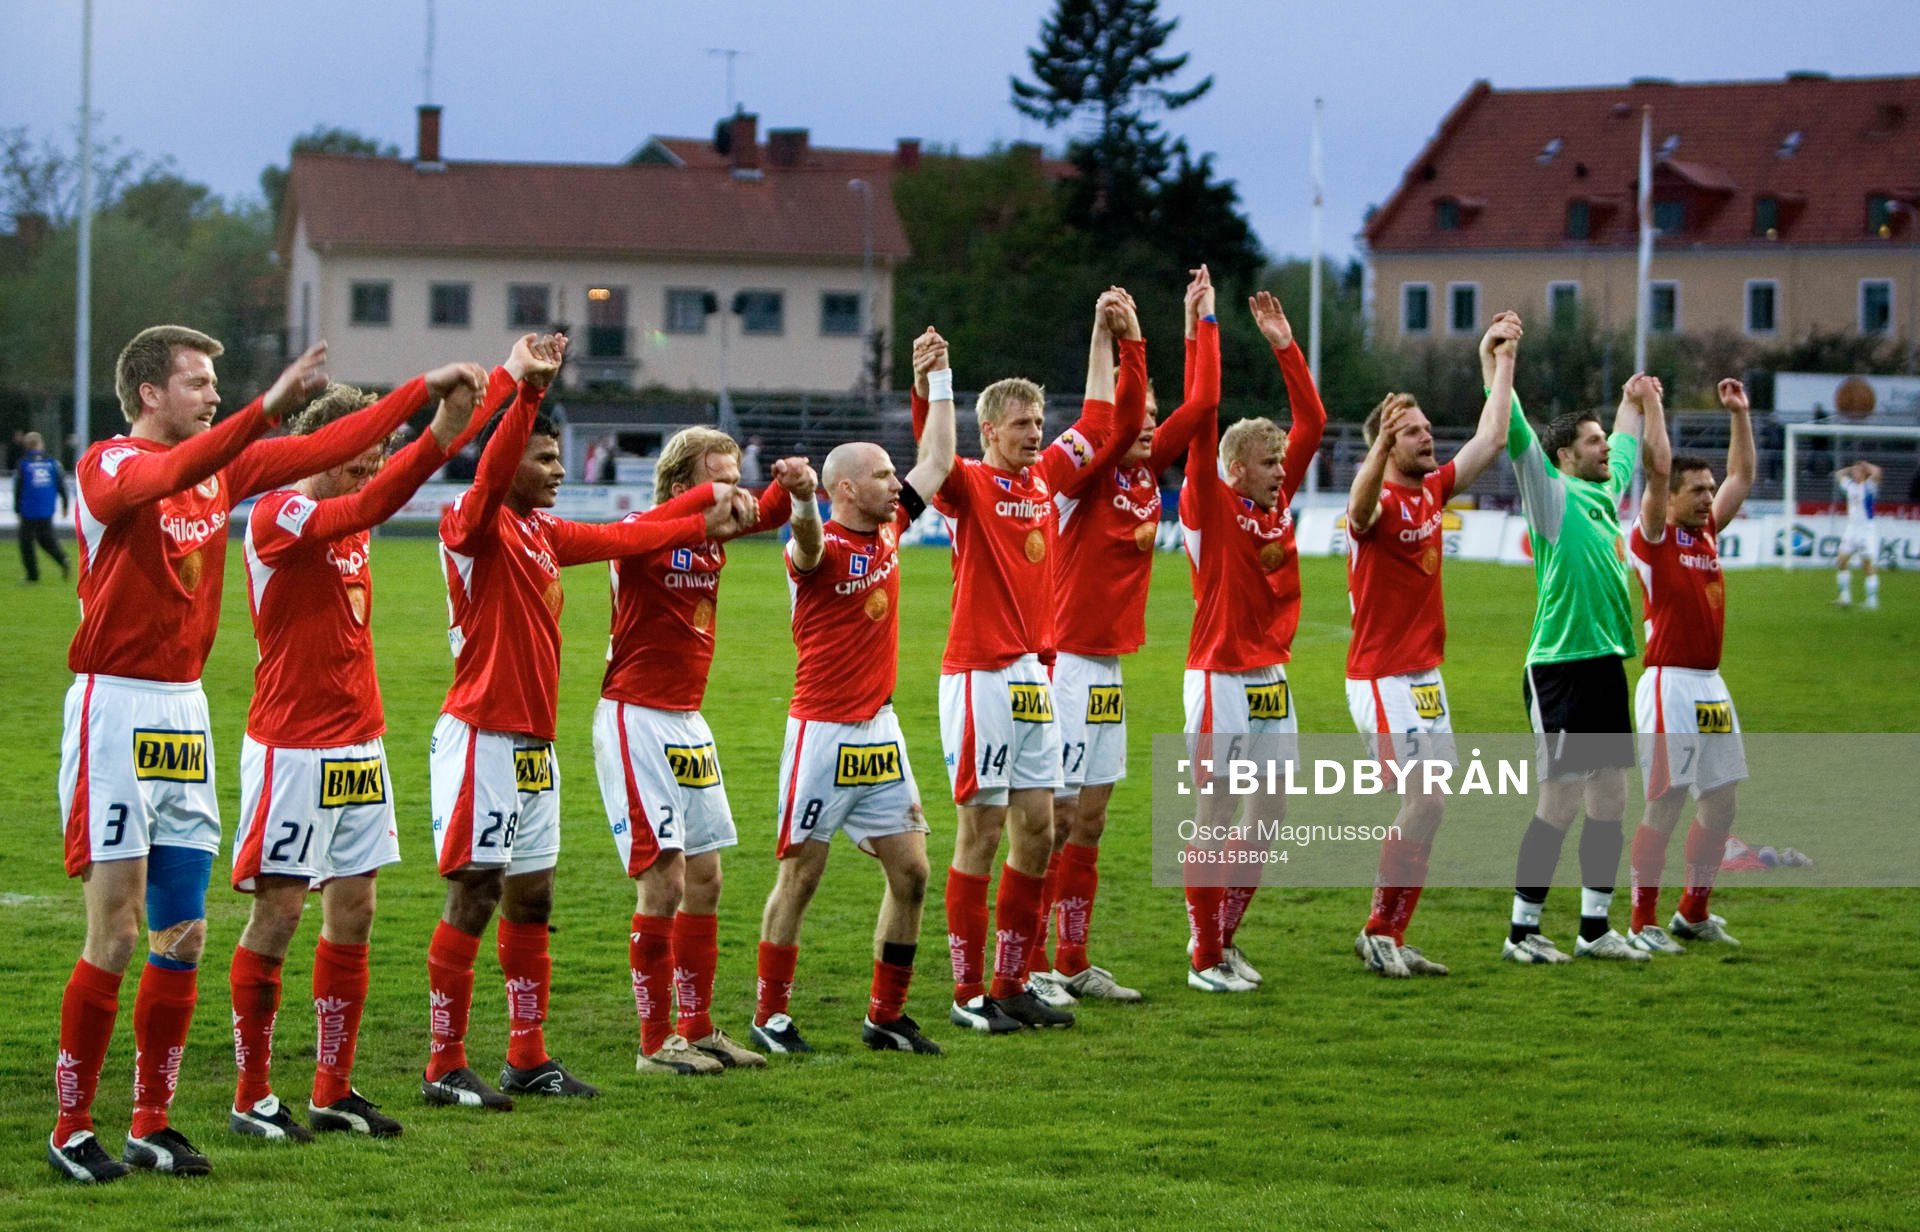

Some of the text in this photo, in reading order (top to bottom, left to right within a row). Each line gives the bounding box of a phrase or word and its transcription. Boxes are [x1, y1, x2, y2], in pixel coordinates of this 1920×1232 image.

[138, 740, 202, 771] BMK
[1062, 742, 1086, 773] 17
[1225, 735, 1243, 765] 6
[1406, 726, 1420, 758] 5
[842, 751, 895, 777] BMK
[981, 744, 1009, 776] 14
[1680, 747, 1696, 775] 7
[327, 766, 379, 797] BMK
[103, 803, 128, 847] 3
[477, 811, 518, 848] 28
[658, 805, 674, 839] 2
[800, 798, 823, 830] 8
[270, 821, 313, 863] 21
[323, 1013, 349, 1066] online
